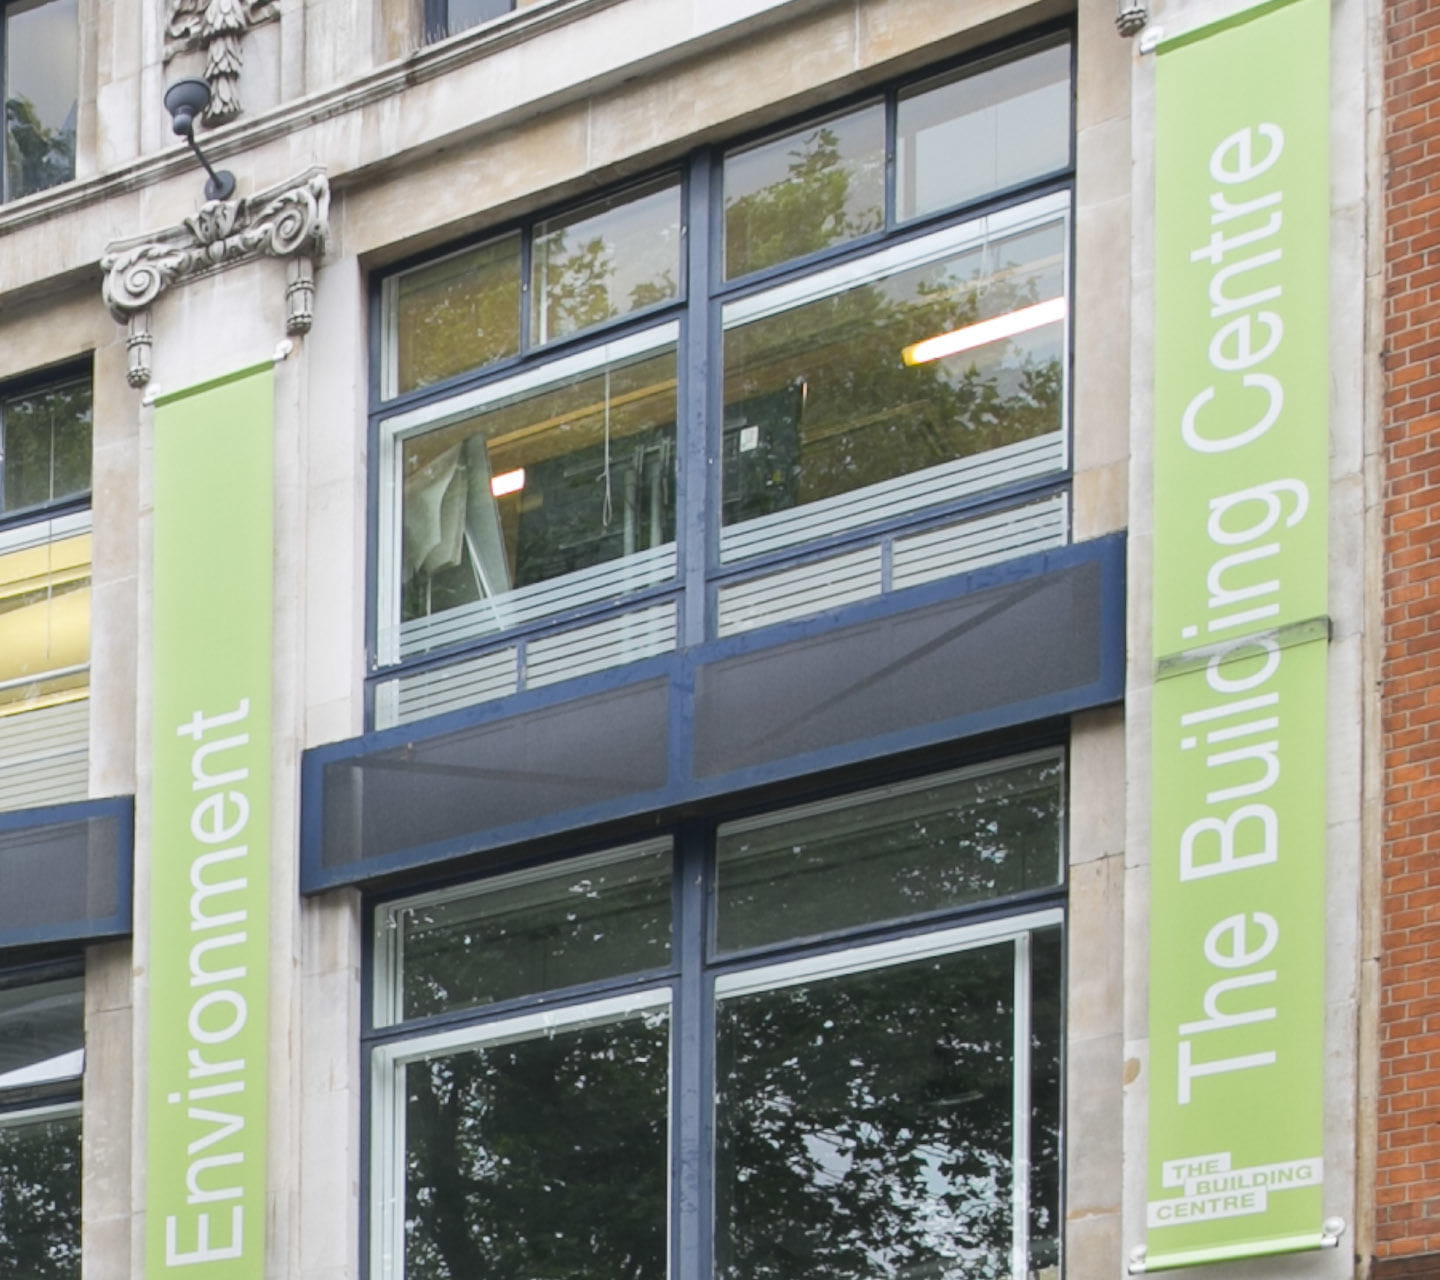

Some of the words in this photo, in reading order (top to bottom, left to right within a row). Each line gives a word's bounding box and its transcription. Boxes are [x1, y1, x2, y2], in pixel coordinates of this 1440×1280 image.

[1181, 122, 1285, 454] Centre
[1180, 477, 1310, 882] Building
[164, 698, 251, 1268] Environment
[1178, 912, 1280, 1105] The
[1156, 1192, 1255, 1220] CENTRE
[1171, 1160, 1220, 1180] THE
[1196, 1165, 1313, 1195] BUILDING
